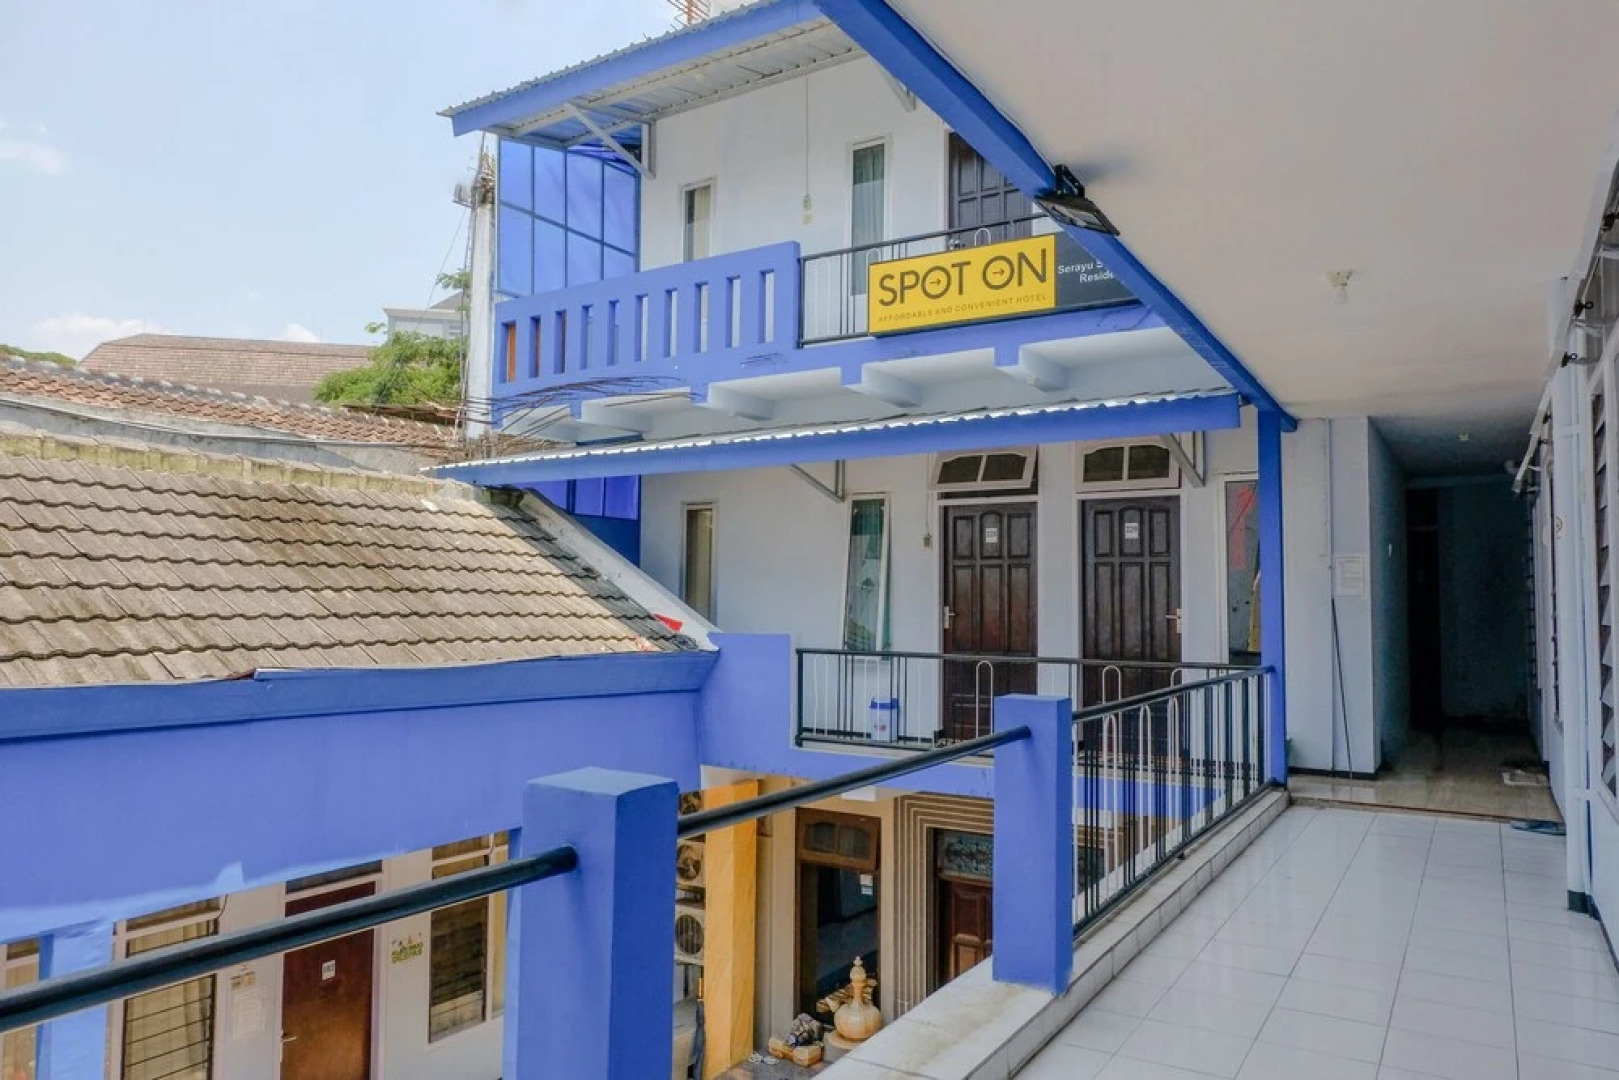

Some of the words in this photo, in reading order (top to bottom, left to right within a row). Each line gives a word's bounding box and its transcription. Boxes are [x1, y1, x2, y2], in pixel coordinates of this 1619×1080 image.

[879, 260, 971, 307] SPOT
[982, 248, 1047, 290] ON
[1058, 262, 1094, 275] Serayu
[878, 310, 933, 323] AFFORDABLE
[935, 306, 952, 315] AND
[954, 298, 1013, 312] CONVENIENT
[1016, 293, 1047, 304] HOTEL
